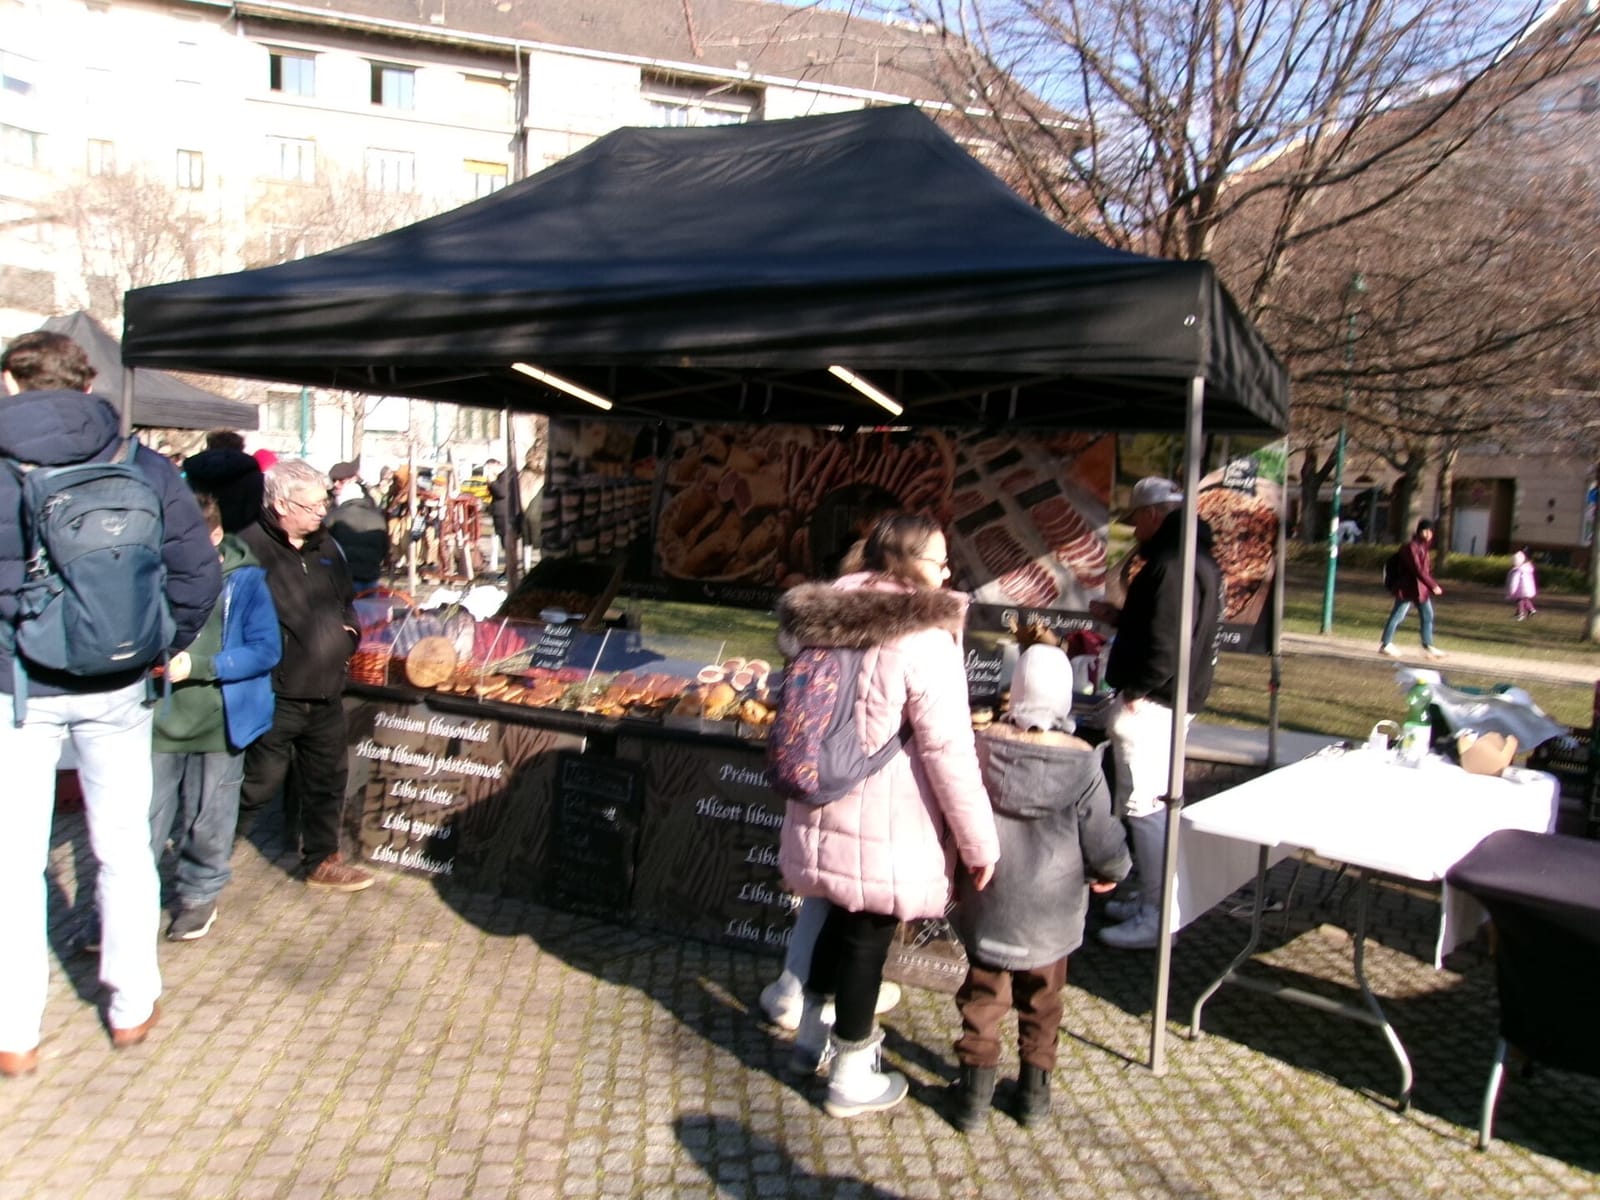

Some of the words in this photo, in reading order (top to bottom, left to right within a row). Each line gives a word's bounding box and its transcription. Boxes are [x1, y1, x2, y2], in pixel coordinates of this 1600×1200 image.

[374, 711, 425, 733] Prémium
[427, 715, 490, 742] libasonkák
[391, 743, 436, 775] libamáj
[431, 754, 503, 779] pástétomok
[719, 763, 771, 787] Prémi
[389, 779, 417, 799] Liba
[382, 811, 411, 832] Liba
[745, 803, 784, 829] libam
[370, 843, 399, 863] Liba
[737, 882, 773, 904] Liba
[725, 918, 760, 941] Liba
